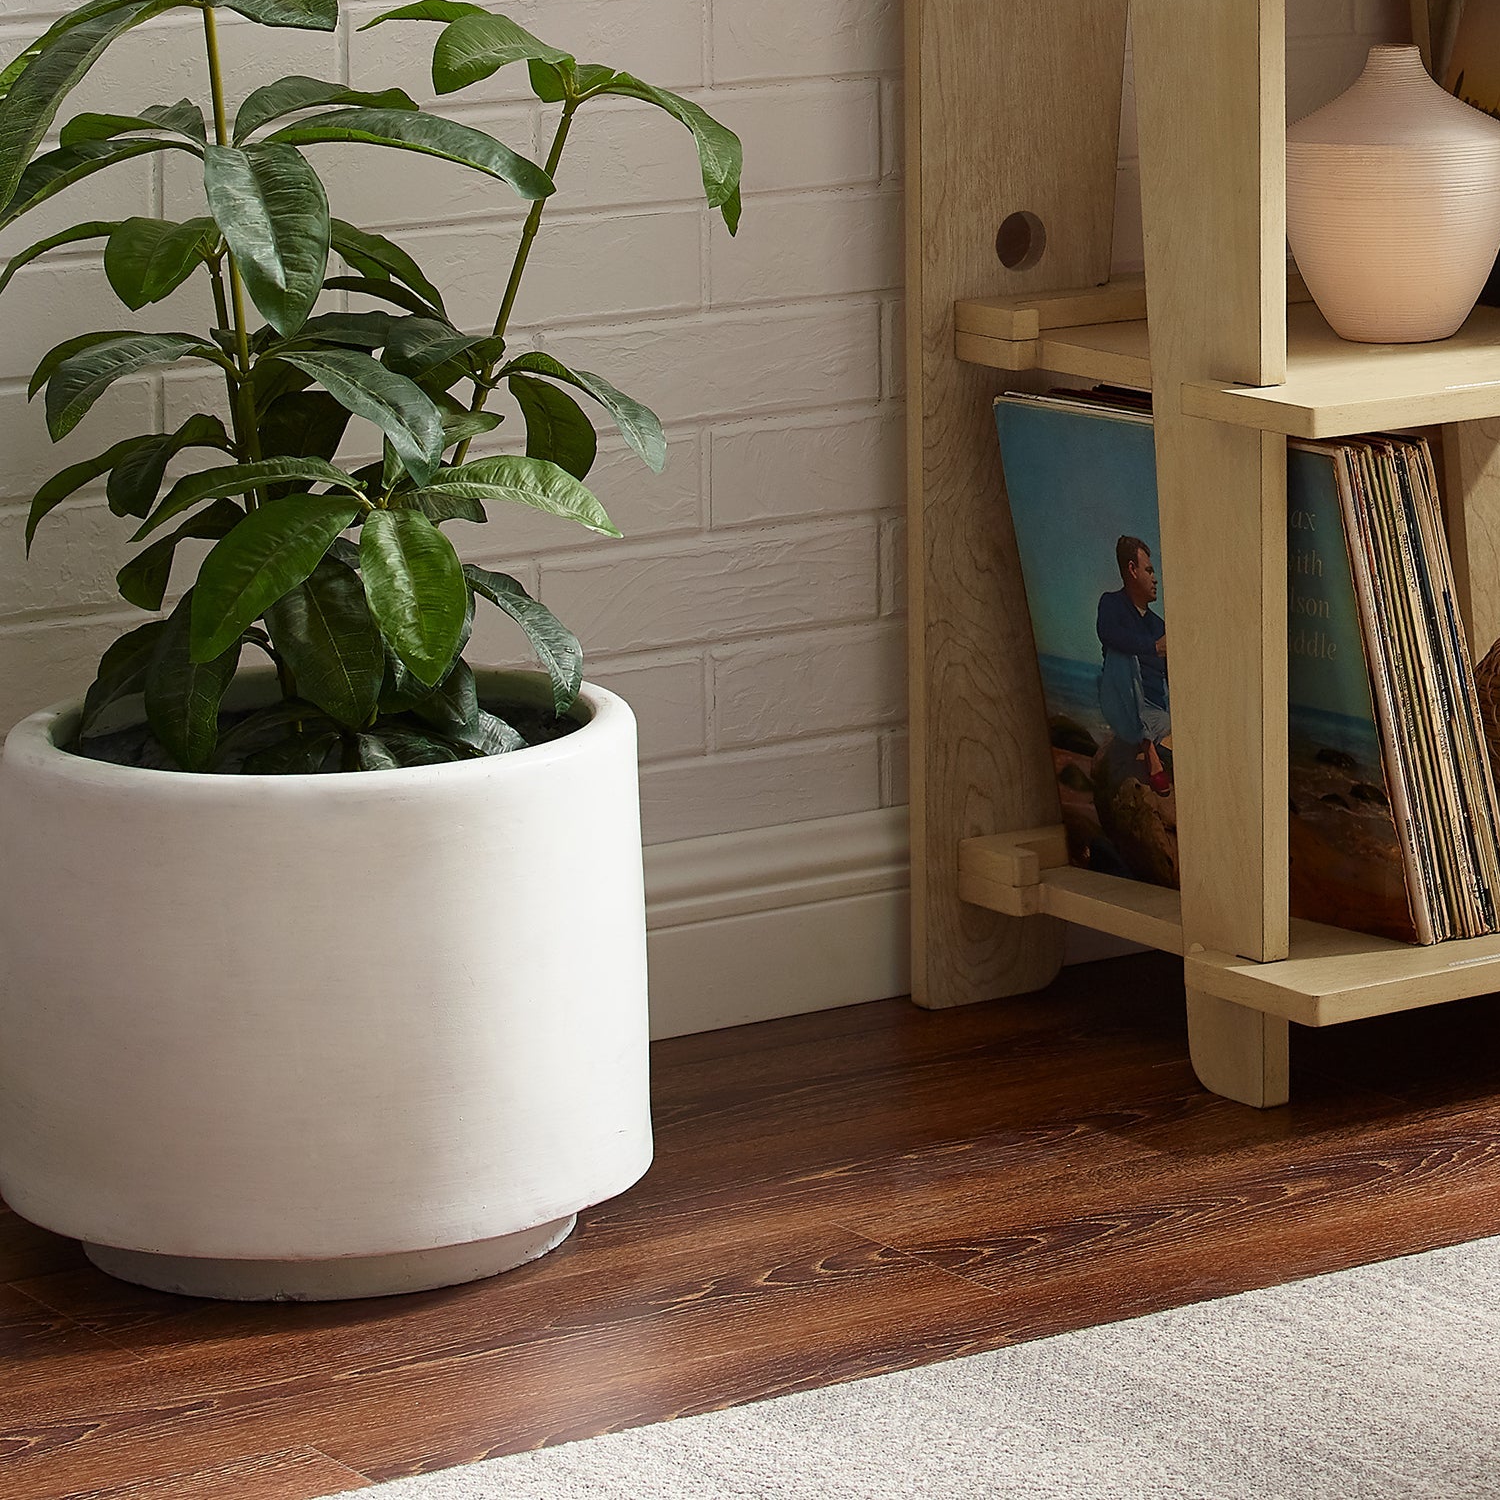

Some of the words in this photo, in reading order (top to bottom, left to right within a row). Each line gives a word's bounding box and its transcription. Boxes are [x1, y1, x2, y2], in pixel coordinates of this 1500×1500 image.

[1290, 509, 1316, 532] ax
[1290, 587, 1330, 619] lson
[1290, 629, 1337, 661] iddle
